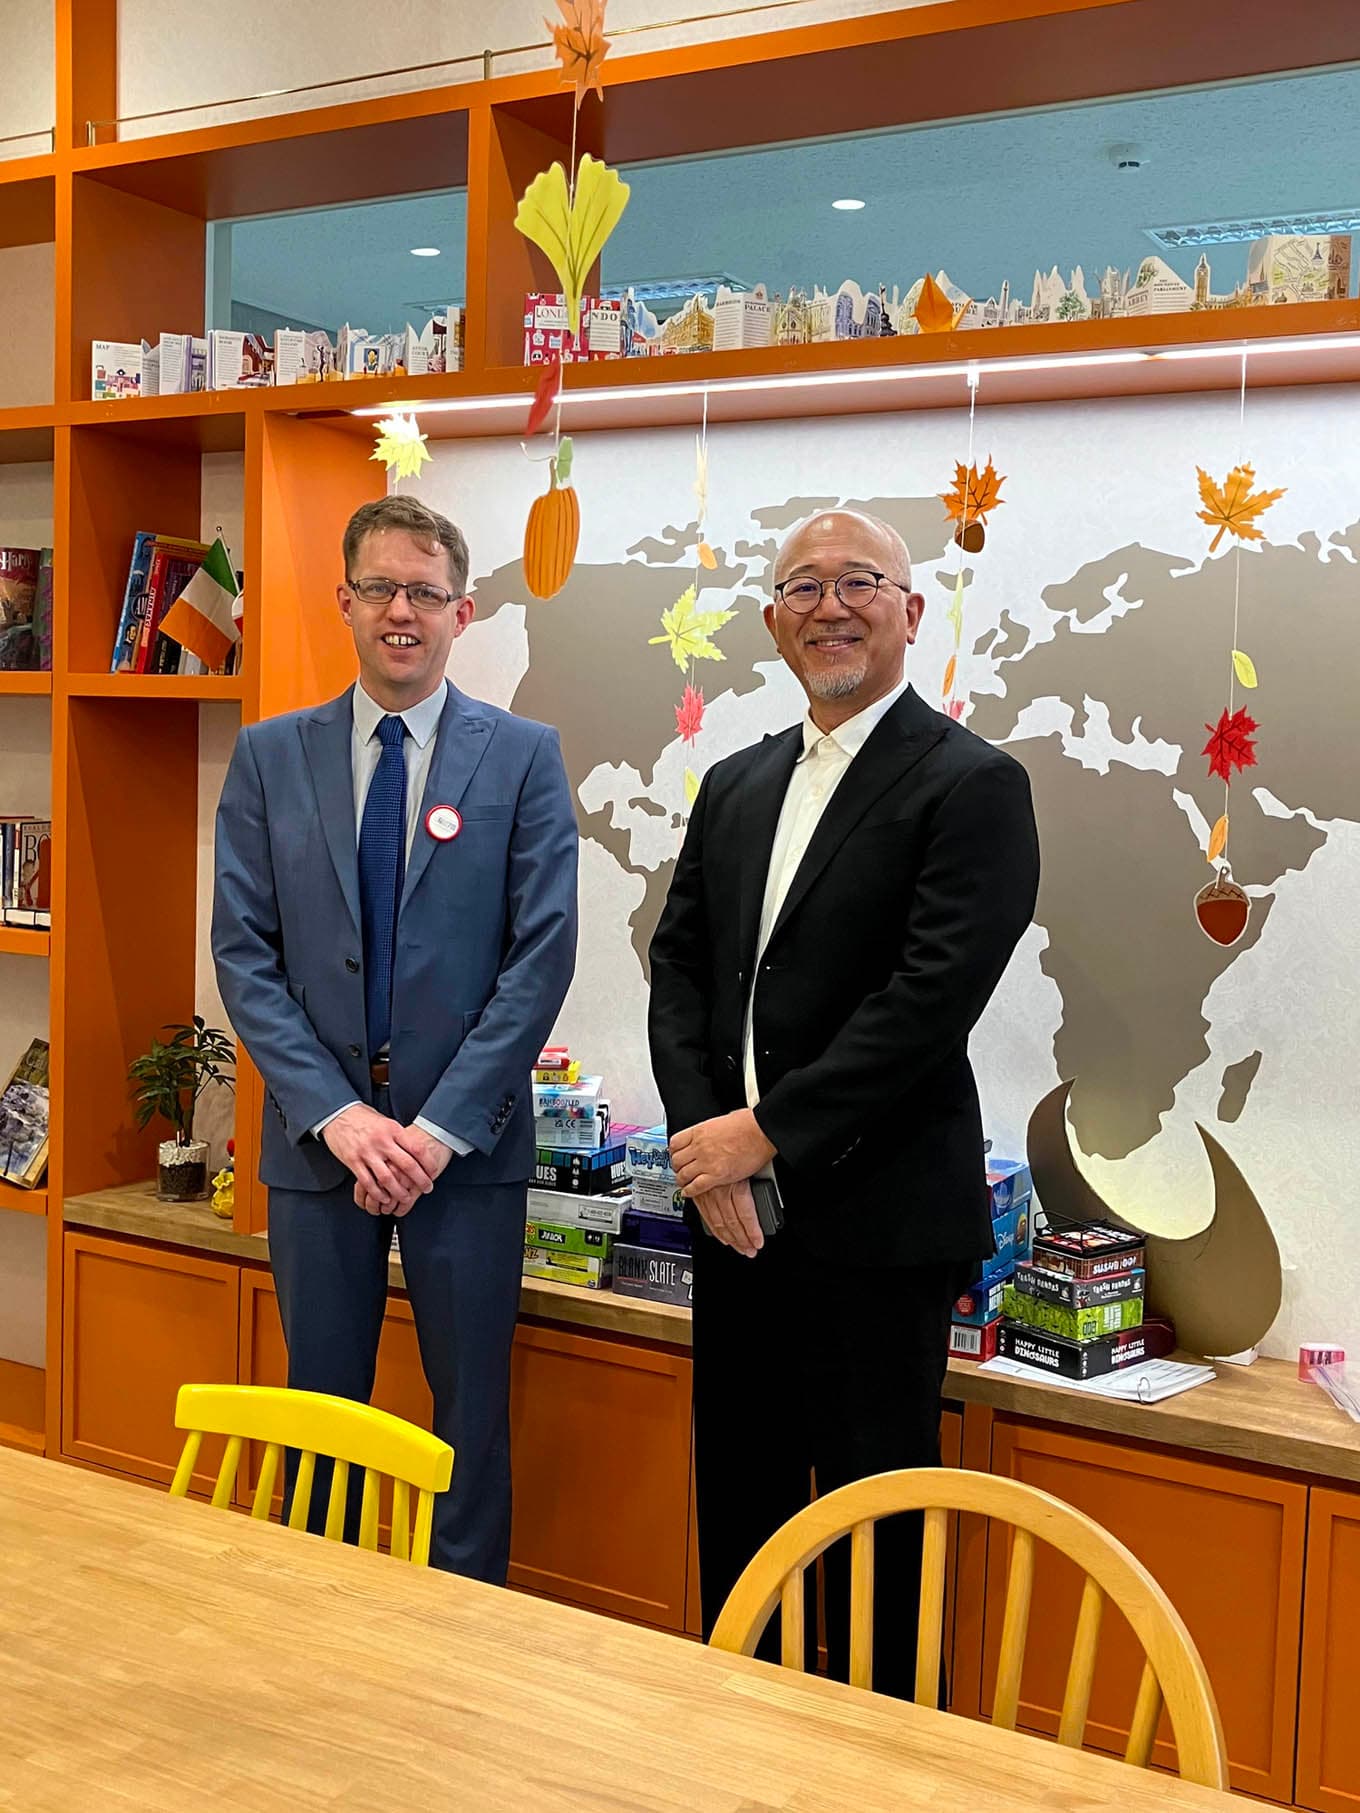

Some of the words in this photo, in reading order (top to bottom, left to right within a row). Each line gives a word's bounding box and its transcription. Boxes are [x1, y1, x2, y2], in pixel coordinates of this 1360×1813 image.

[744, 304, 771, 313] PALACE
[649, 1260, 676, 1286] SLATE
[1015, 1338, 1036, 1351] HAPPY
[1038, 1345, 1060, 1358] LITTLE
[1111, 1344, 1128, 1355] HAPPY
[1128, 1338, 1145, 1349] LITTLE
[1014, 1346, 1060, 1368] DINOSAURS
